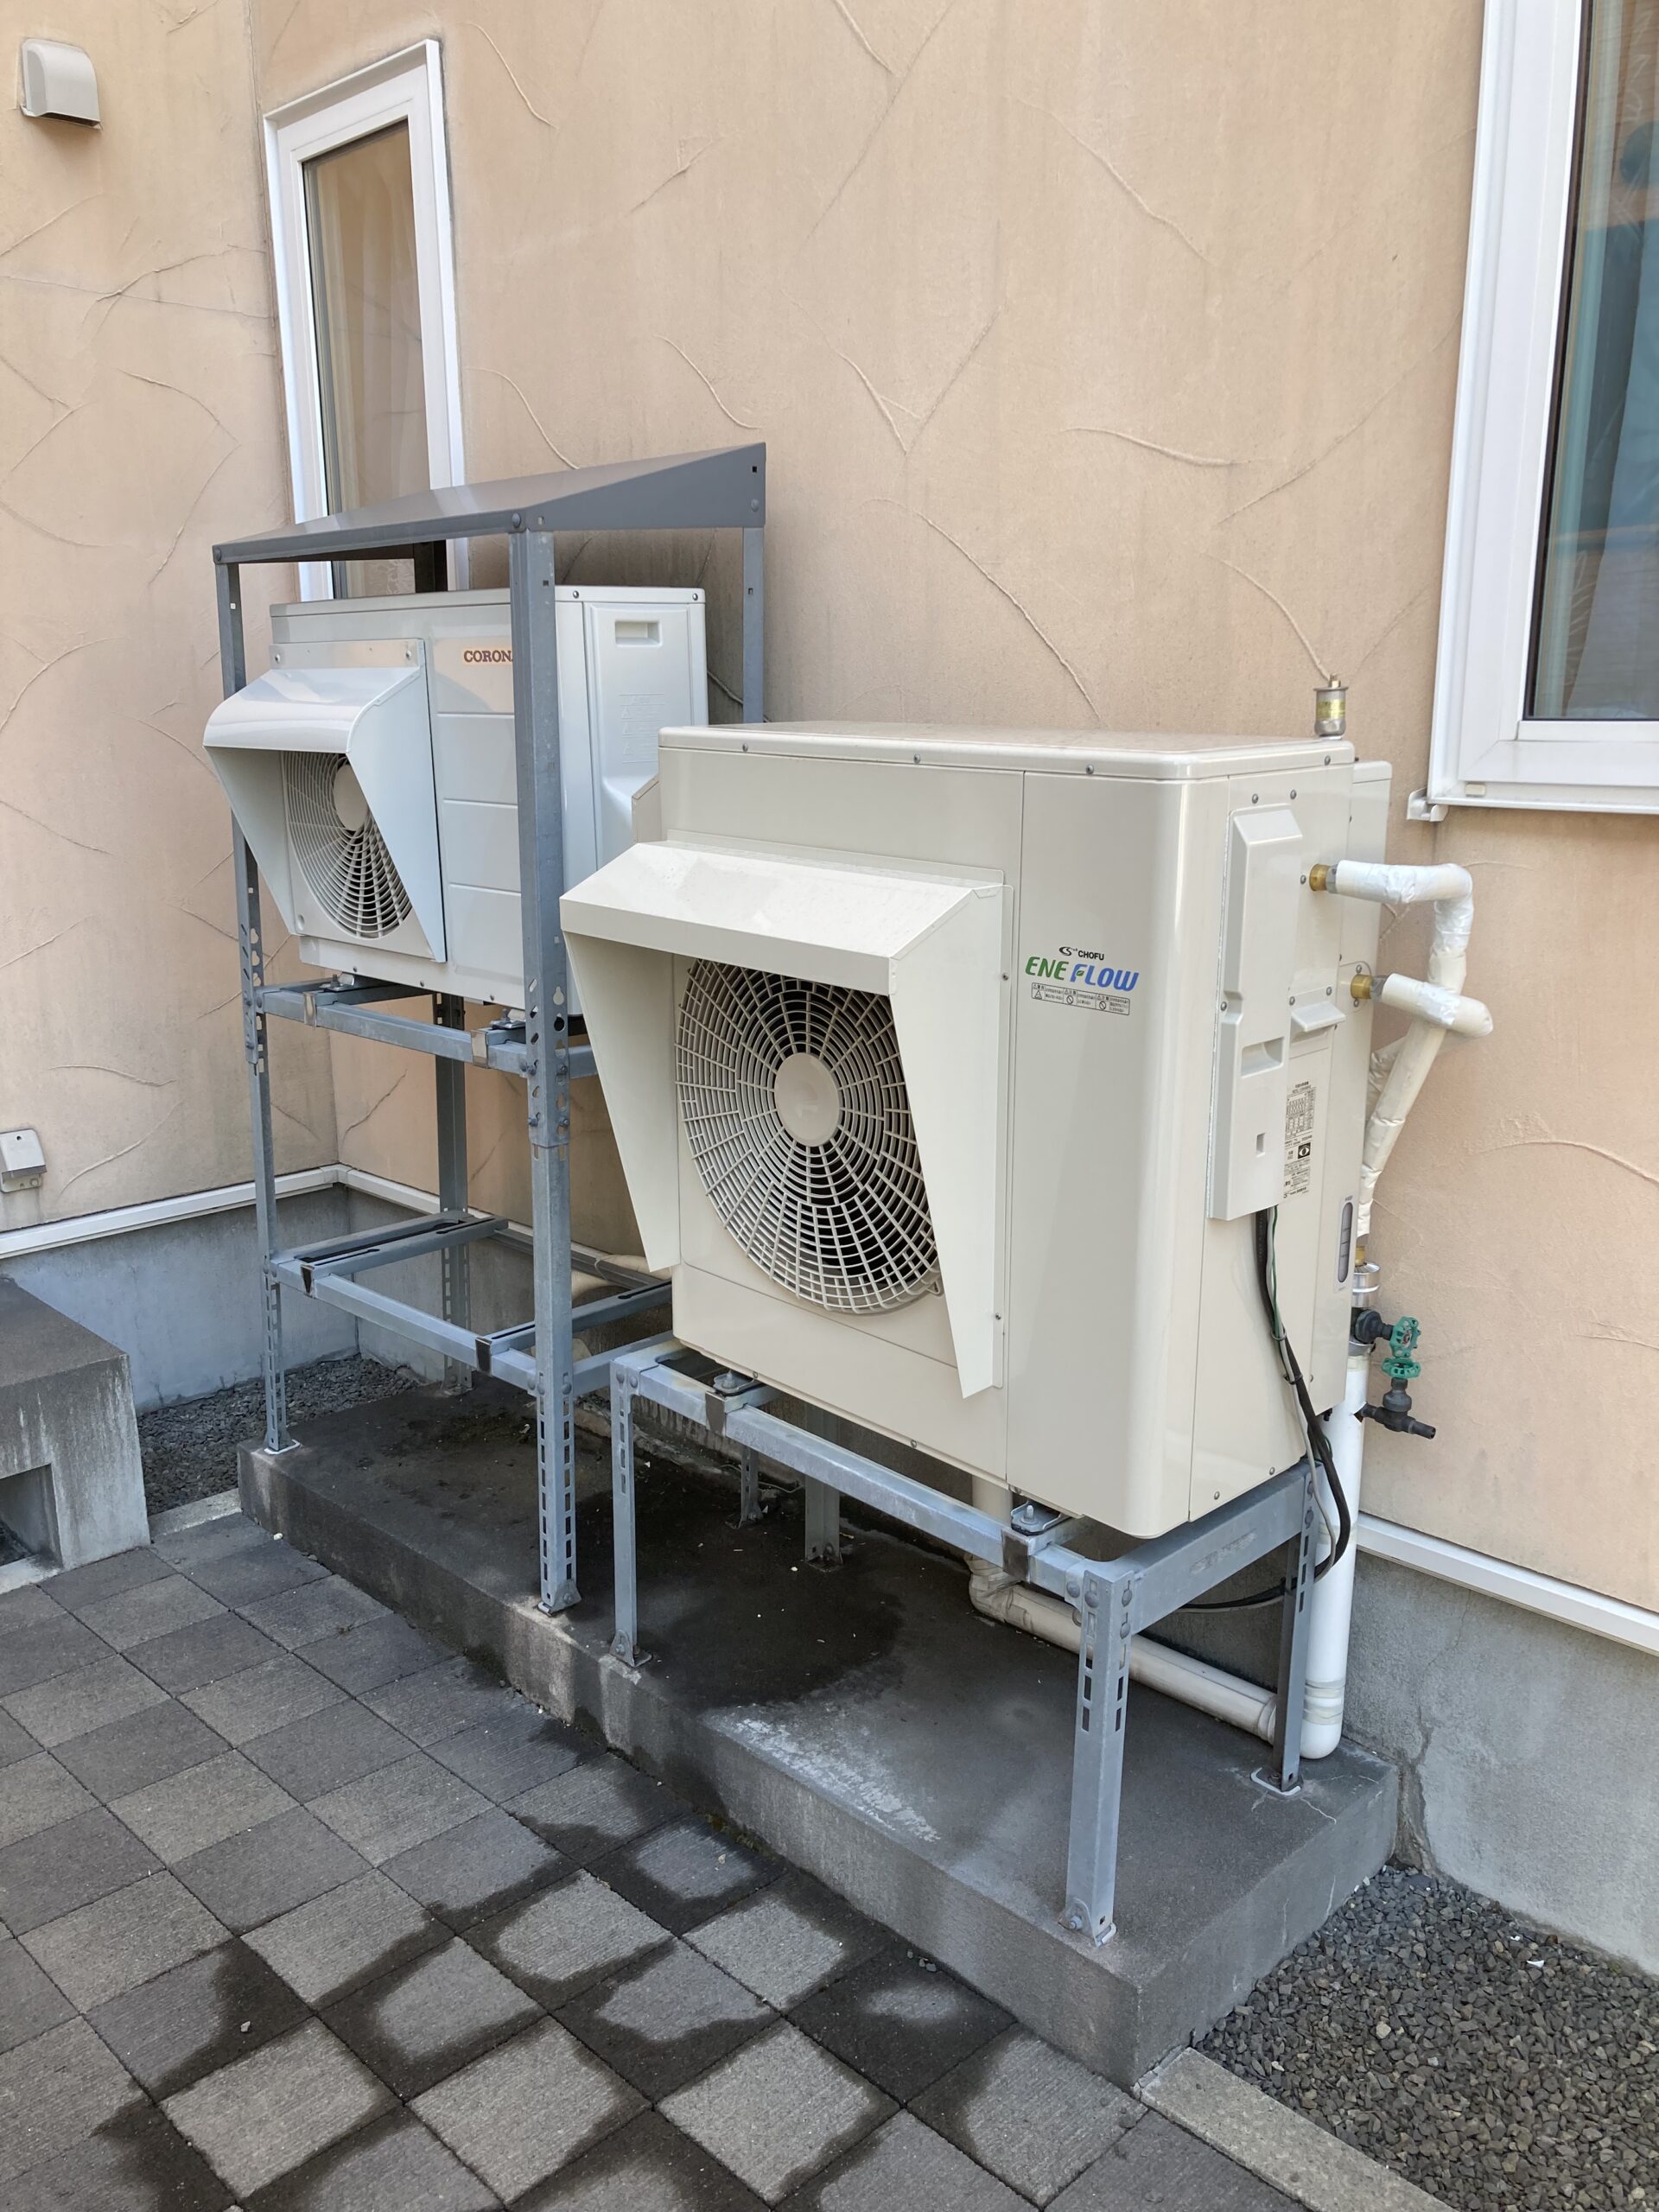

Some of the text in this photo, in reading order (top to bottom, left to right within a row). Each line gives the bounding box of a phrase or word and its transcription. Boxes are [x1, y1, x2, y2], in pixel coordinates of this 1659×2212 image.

[463, 650, 513, 663] CORON
[1077, 950, 1104, 961] CHOFU
[1025, 957, 1069, 981] ENE
[1070, 963, 1139, 992] FLOW
